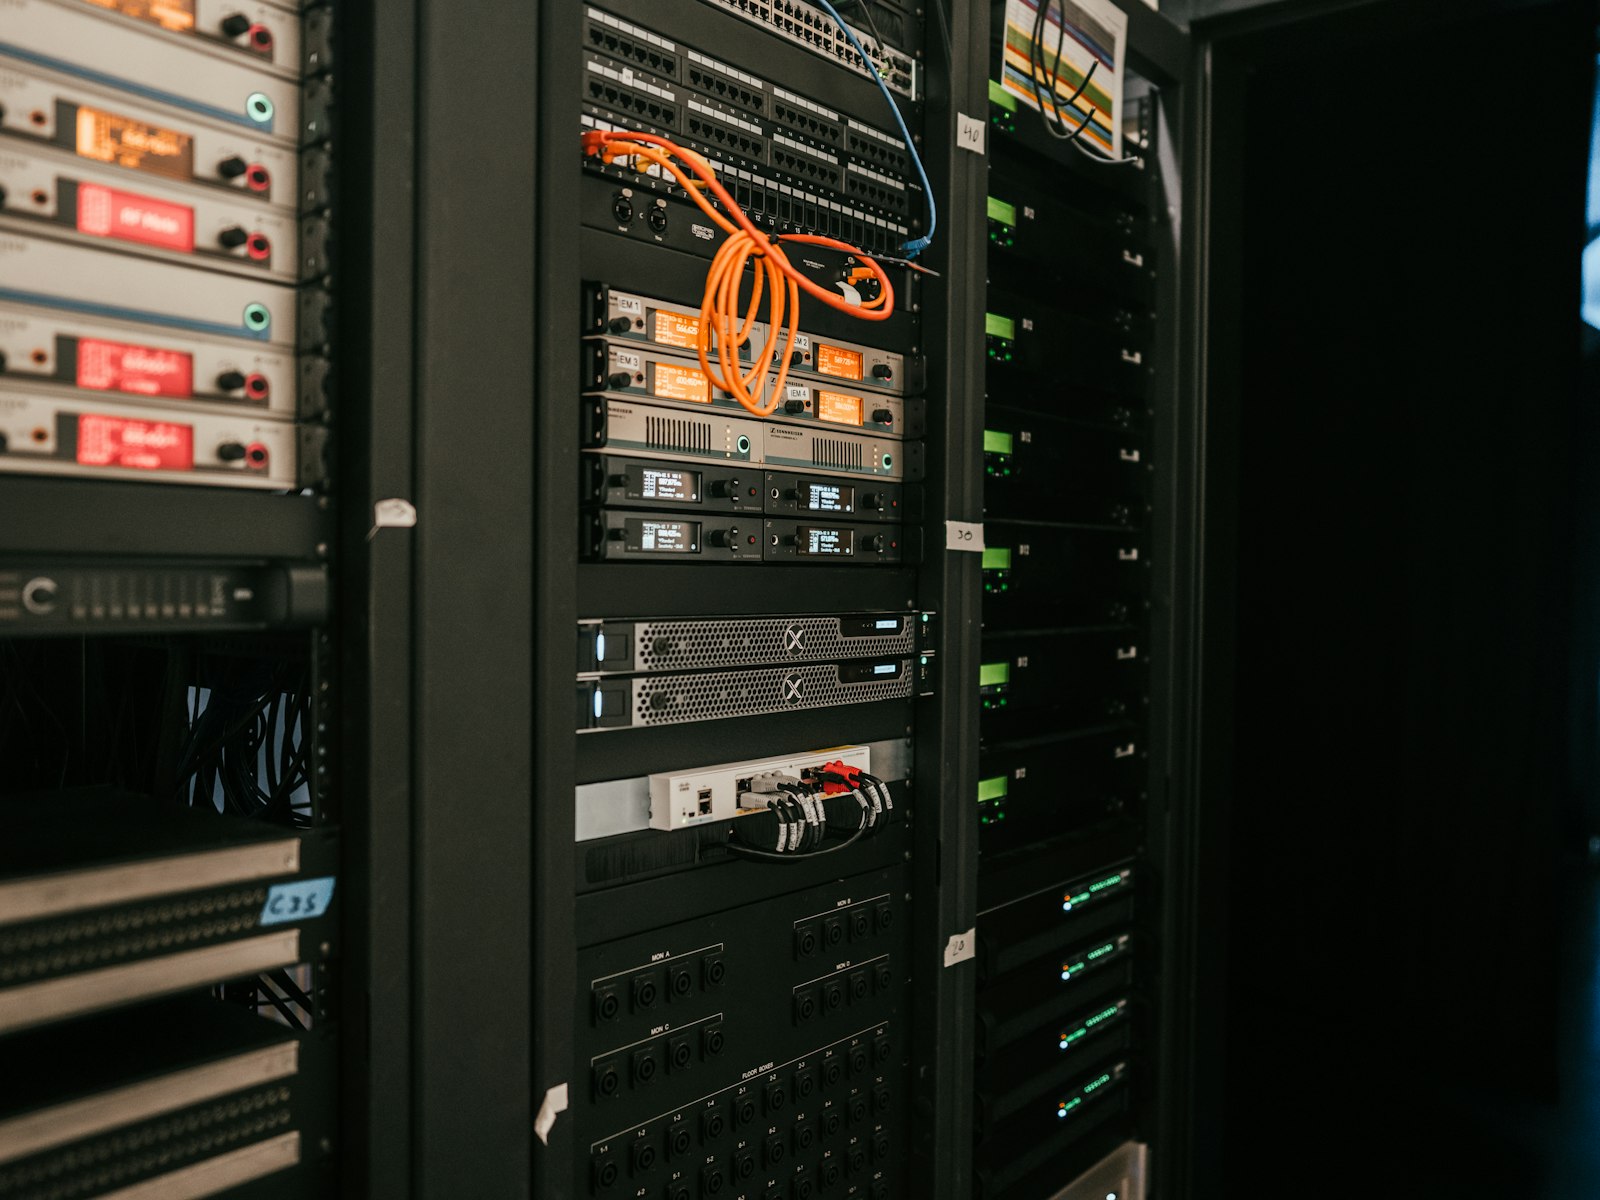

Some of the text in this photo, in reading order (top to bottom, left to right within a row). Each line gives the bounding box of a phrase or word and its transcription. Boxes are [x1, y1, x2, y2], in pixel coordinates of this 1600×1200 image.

[964, 124, 980, 142] 40
[616, 353, 632, 364] IEM
[790, 389, 802, 397] IEM
[958, 530, 973, 541] 30
[652, 952, 664, 962] MON
[650, 1026, 664, 1035] MON
[742, 1062, 774, 1080] FLOOR BOXES
